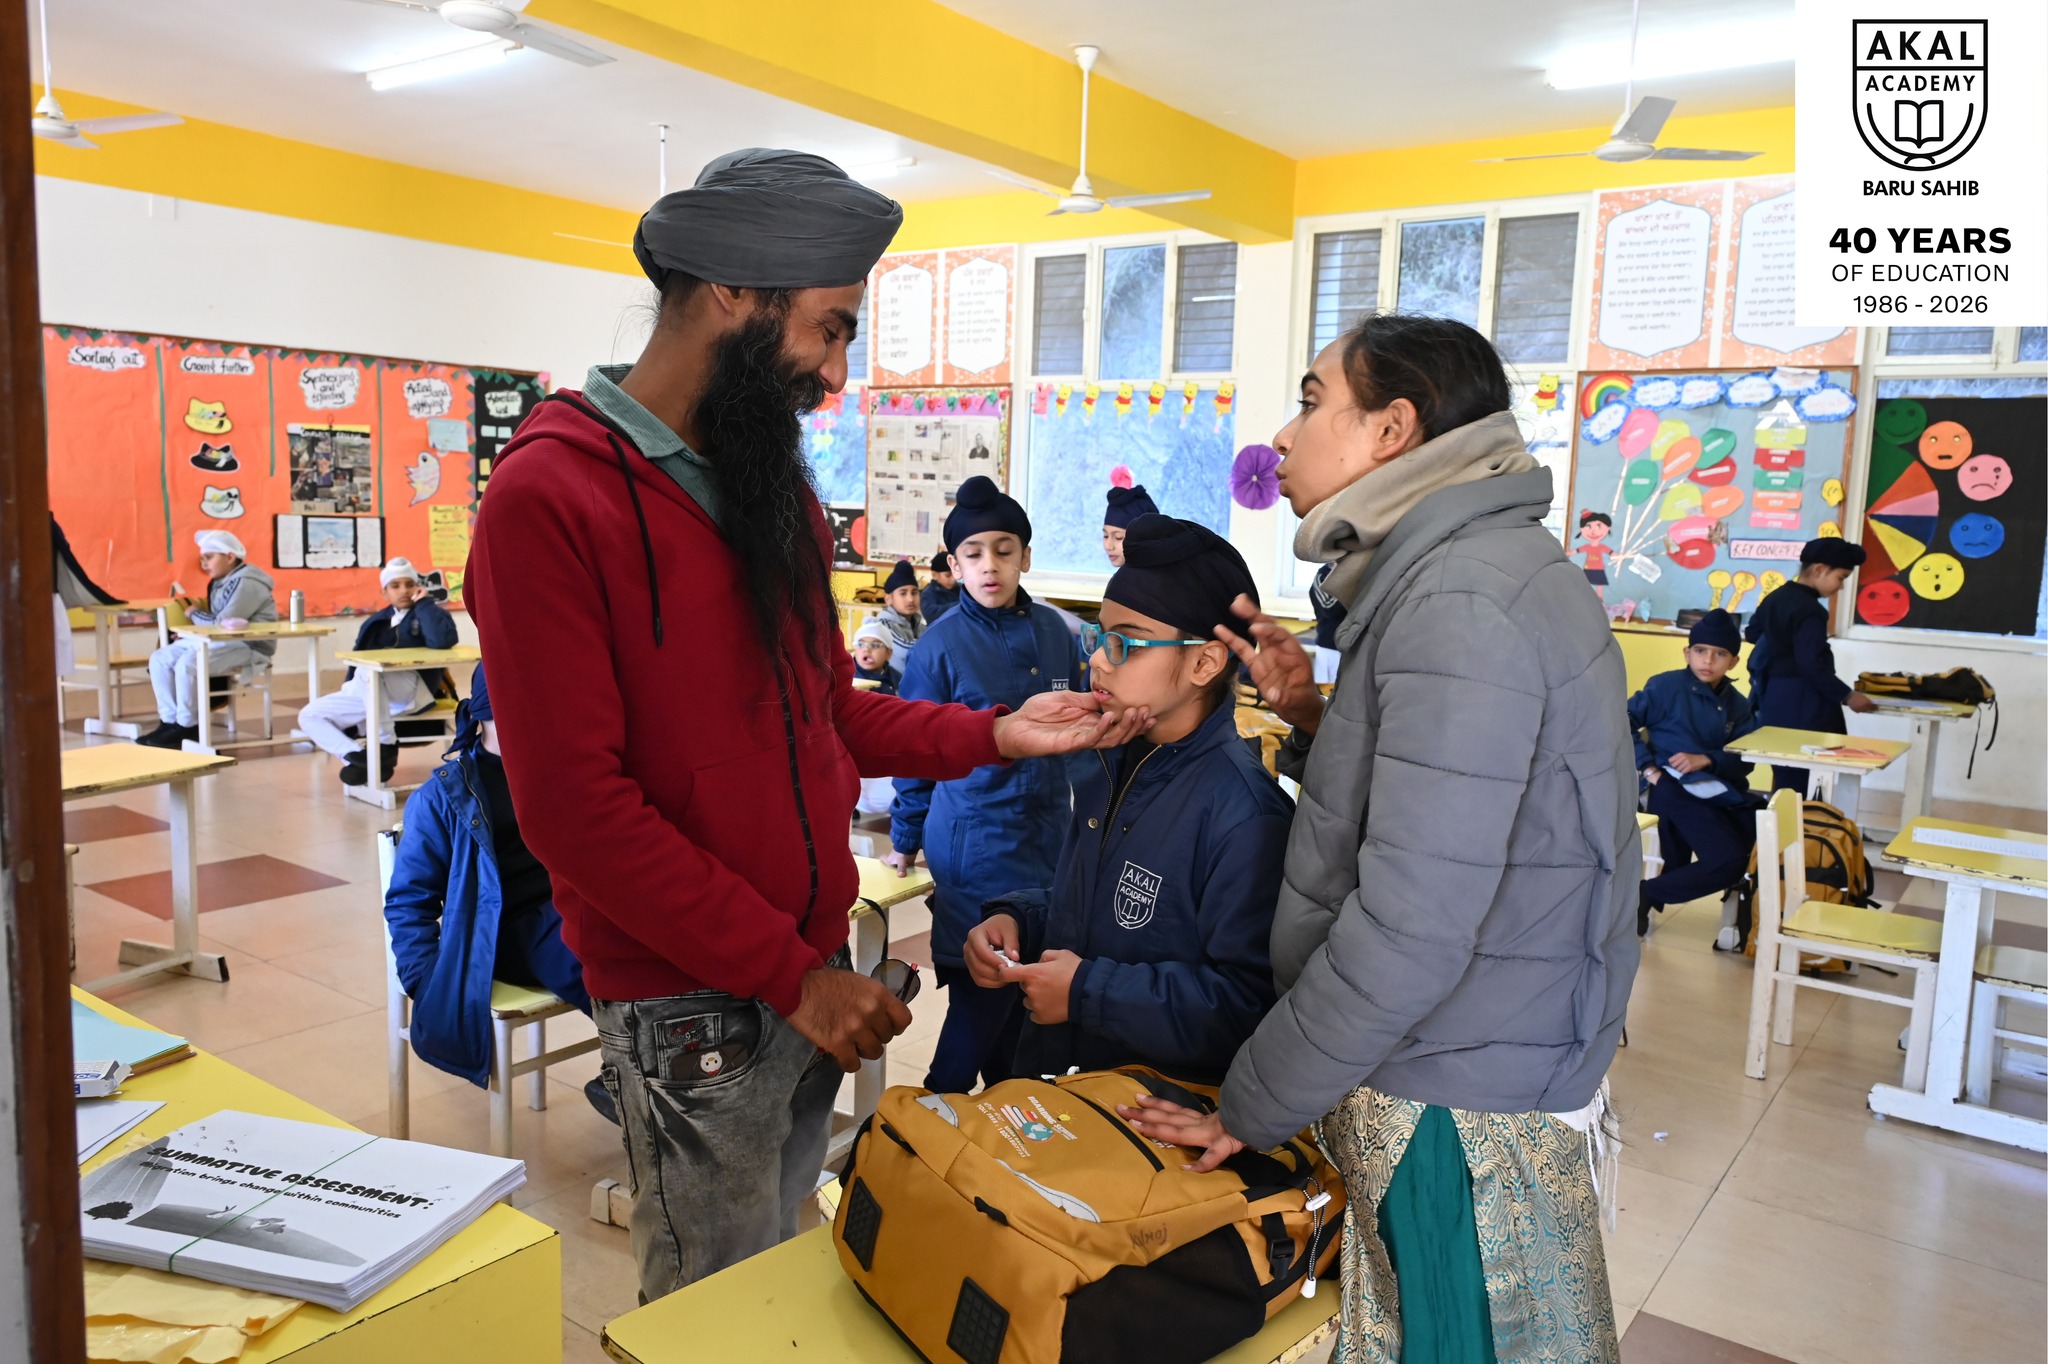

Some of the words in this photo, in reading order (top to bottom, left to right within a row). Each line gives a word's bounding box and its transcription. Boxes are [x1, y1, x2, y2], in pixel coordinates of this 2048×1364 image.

[71, 348, 116, 370] Sorting
[122, 352, 139, 366] out
[1734, 543, 1754, 557] KEY
[1124, 868, 1155, 893] AKAL
[1120, 885, 1153, 906] ACADEMY
[147, 1147, 283, 1180] SUMMATIVE
[281, 1173, 434, 1210] ASSESSMENT:
[198, 1173, 239, 1186] brings
[239, 1181, 282, 1195] change
[283, 1191, 323, 1204] within
[325, 1199, 402, 1219] communities
